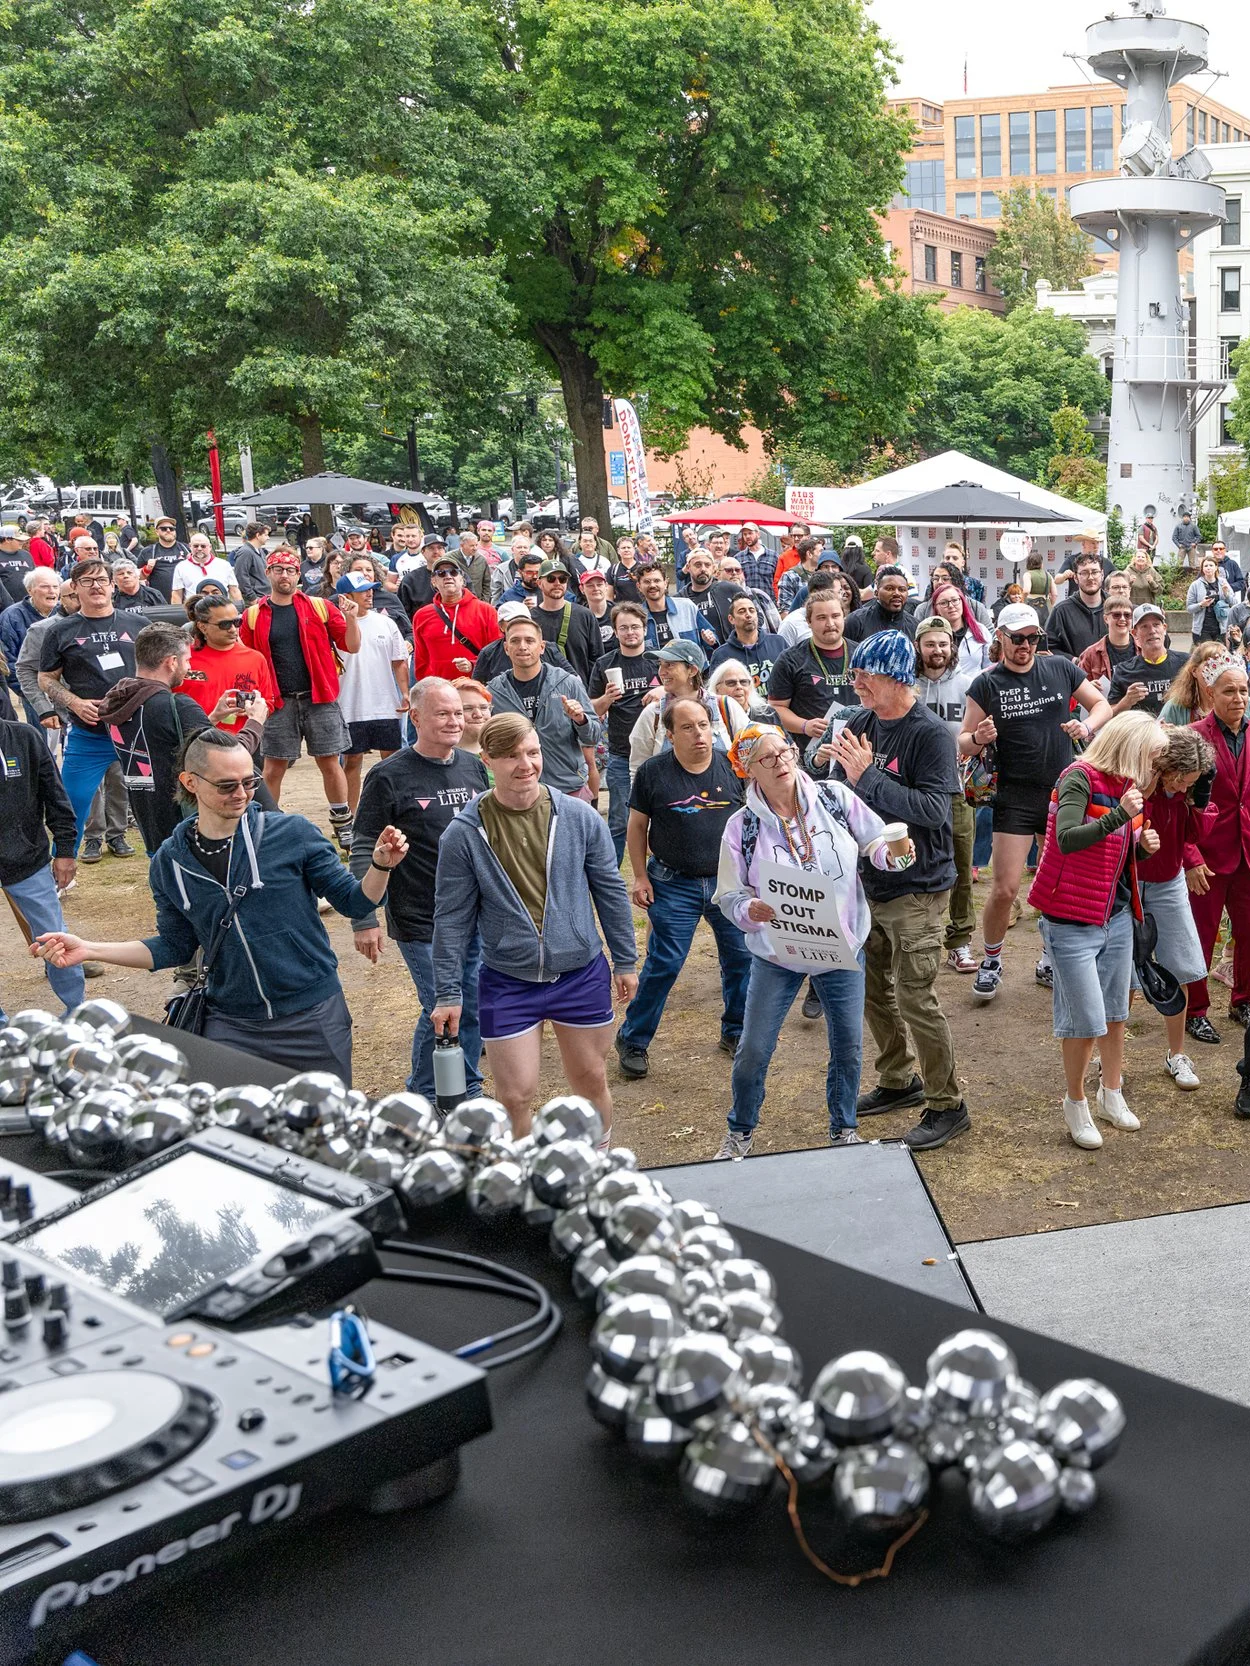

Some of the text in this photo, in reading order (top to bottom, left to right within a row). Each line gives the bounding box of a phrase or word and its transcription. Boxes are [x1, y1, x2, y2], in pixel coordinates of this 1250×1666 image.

[618, 409, 637, 474] DONATE
[791, 490, 814, 498] AIDS
[551, 561, 560, 570] P
[625, 680, 648, 690] LIFE
[1000, 688, 1021, 696] PrEP
[1000, 695, 1021, 704] U=U
[1000, 696, 1056, 711] Doxycycline
[1001, 707, 1043, 719] Jynneos.
[438, 792, 471, 806] LIFE
[768, 879, 825, 903] STOMP
[780, 903, 816, 920] OUT
[769, 919, 839, 939] STIGMA
[800, 950, 842, 963] LIFE
[28, 1482, 303, 1628] Pioneer DJ
